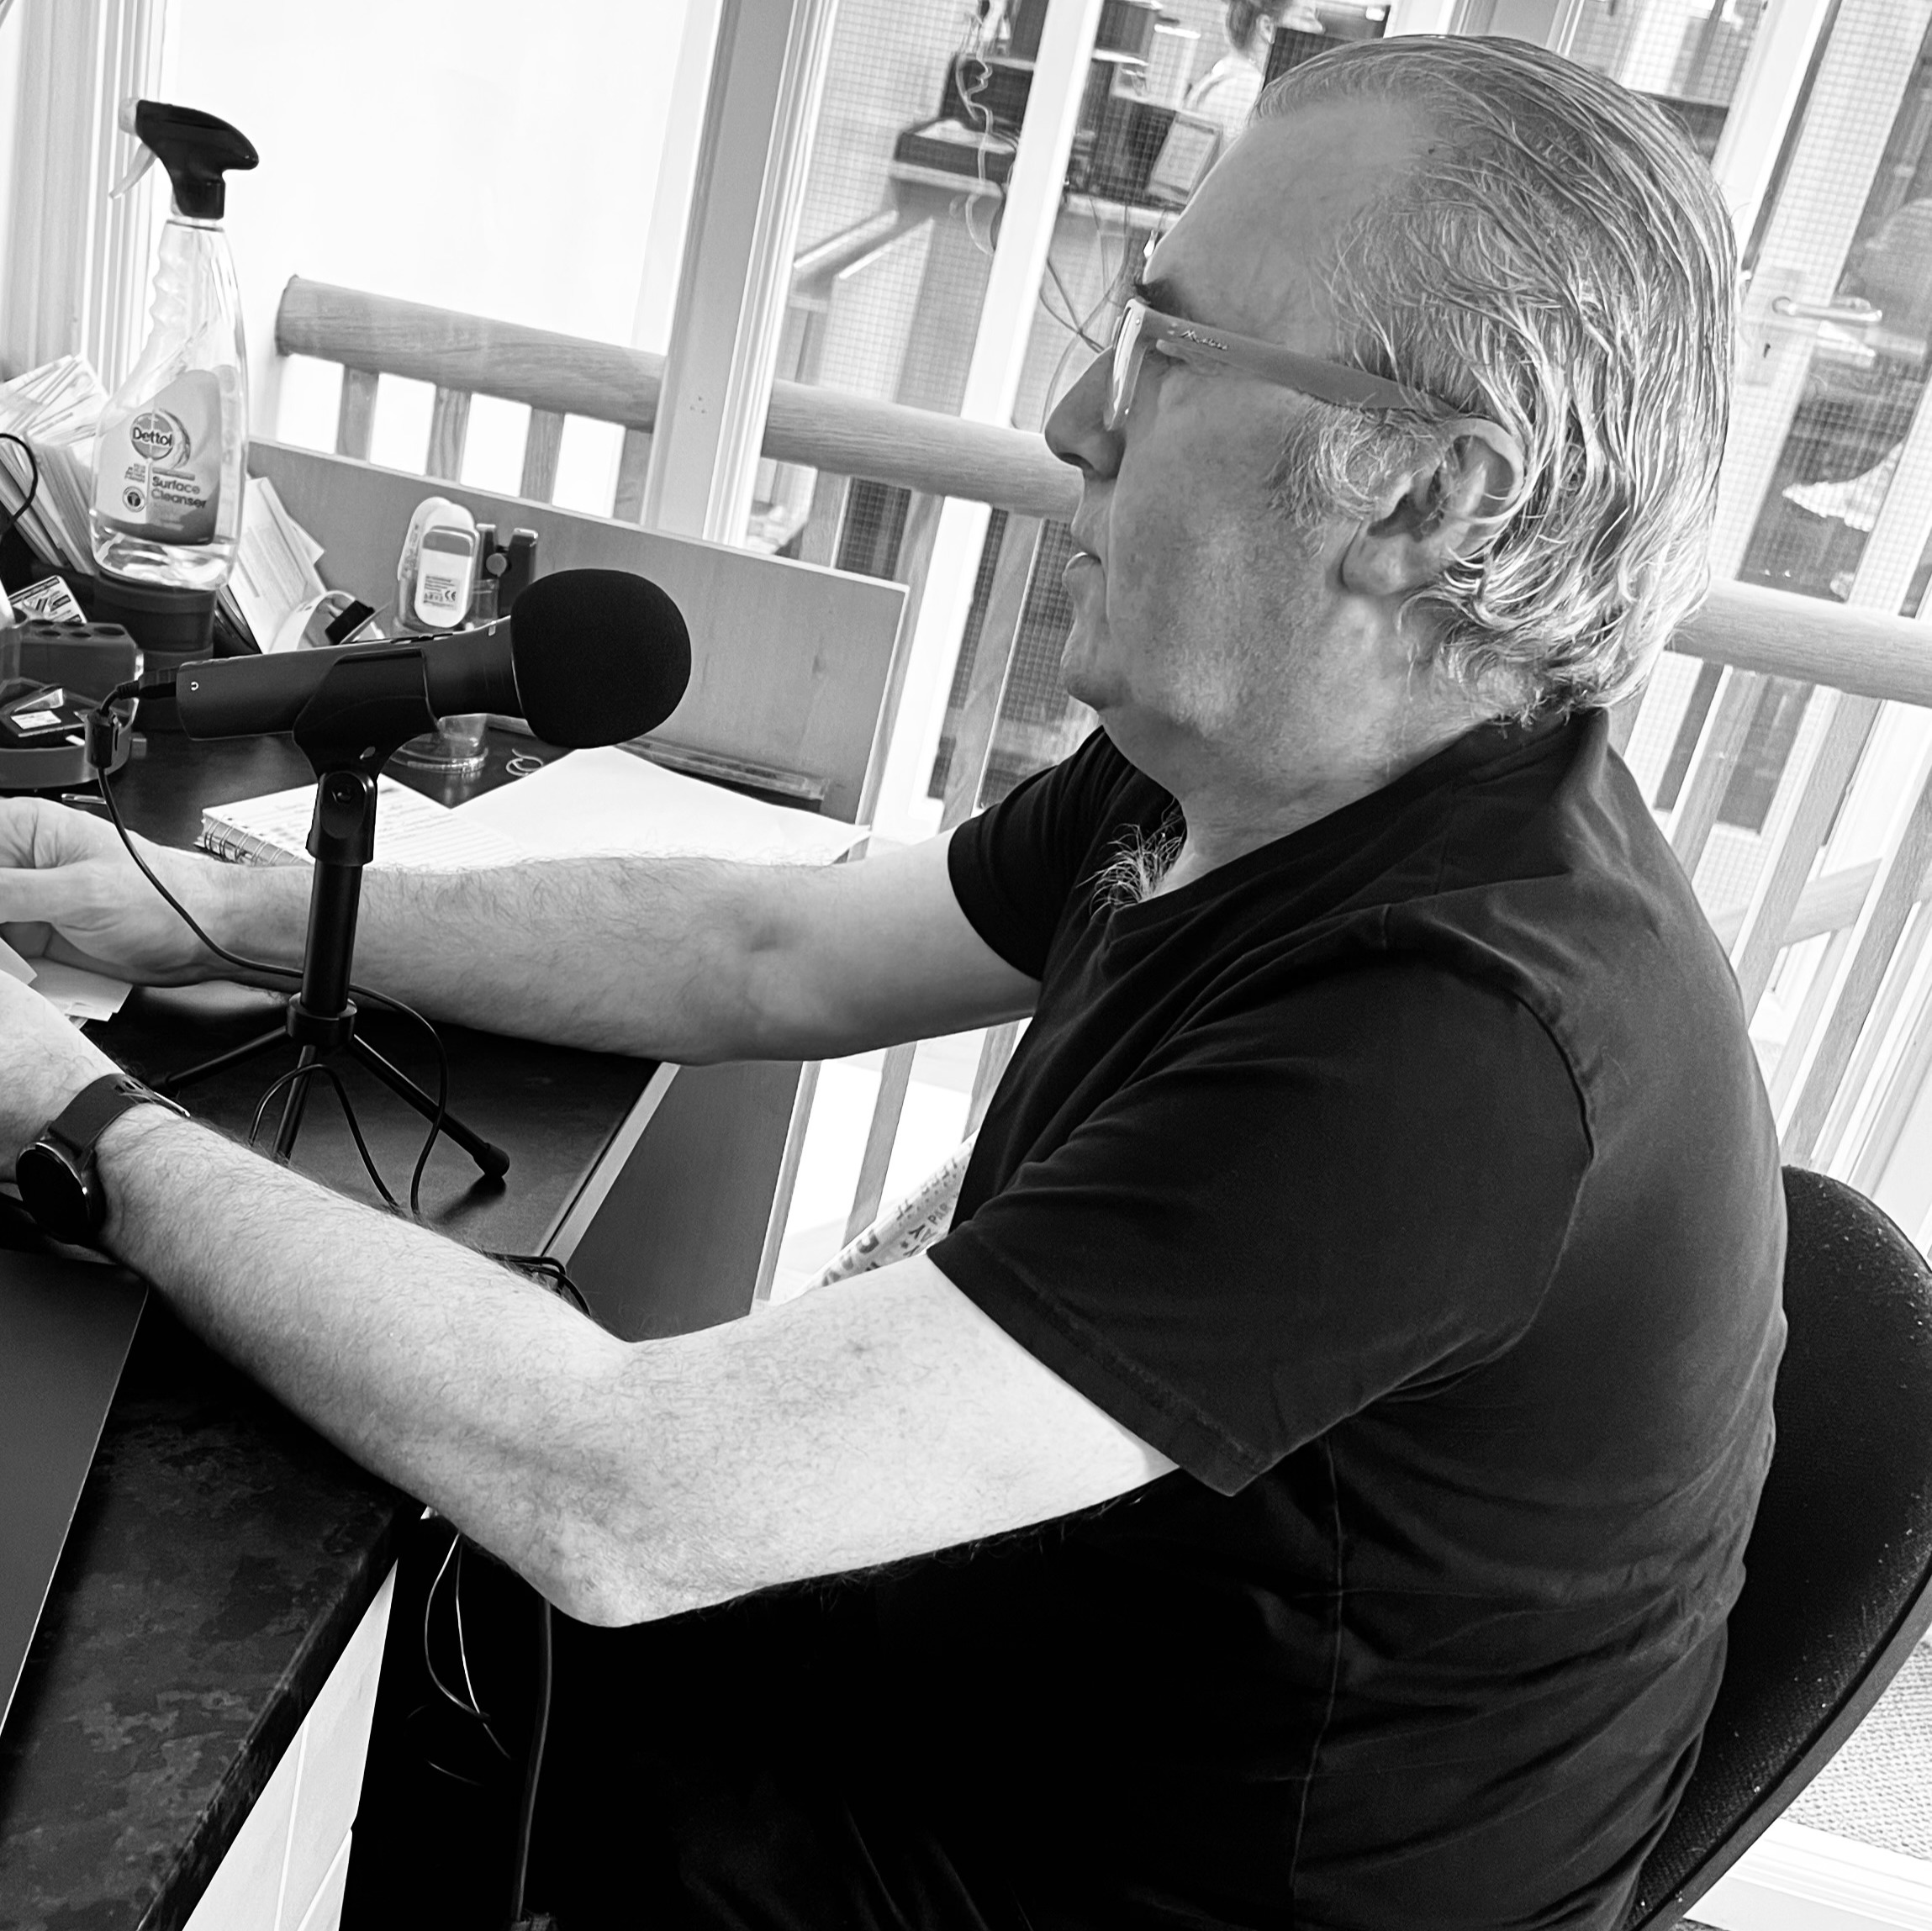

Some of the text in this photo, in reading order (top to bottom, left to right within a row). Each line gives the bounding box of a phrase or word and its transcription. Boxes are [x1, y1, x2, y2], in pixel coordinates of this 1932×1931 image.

[132, 426, 173, 446] Dettol
[152, 476, 201, 495] Surface
[150, 488, 208, 509] Cleanser
